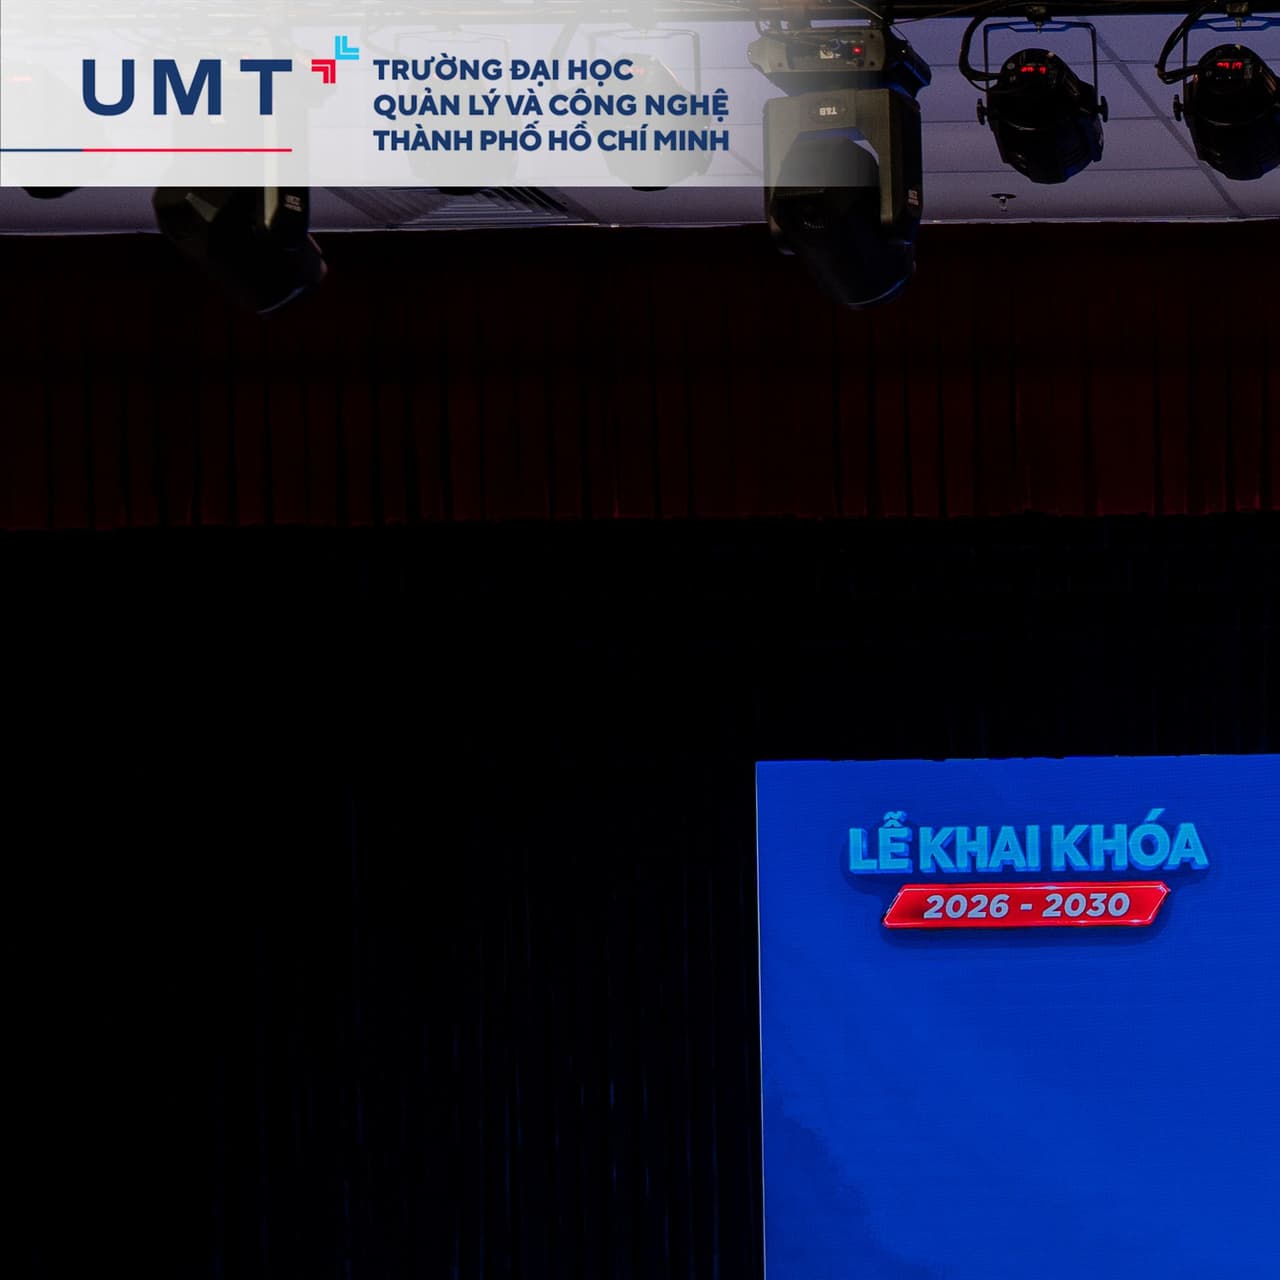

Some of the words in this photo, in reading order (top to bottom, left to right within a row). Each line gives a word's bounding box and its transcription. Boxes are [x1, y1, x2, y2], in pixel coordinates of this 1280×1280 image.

[848, 811, 913, 873] LỄ
[919, 825, 1040, 871] KHAI
[1052, 808, 1209, 871] KHÓA
[923, 893, 1009, 919] 2026
[1020, 903, 1033, 911] -
[1042, 892, 1130, 918] 2030
